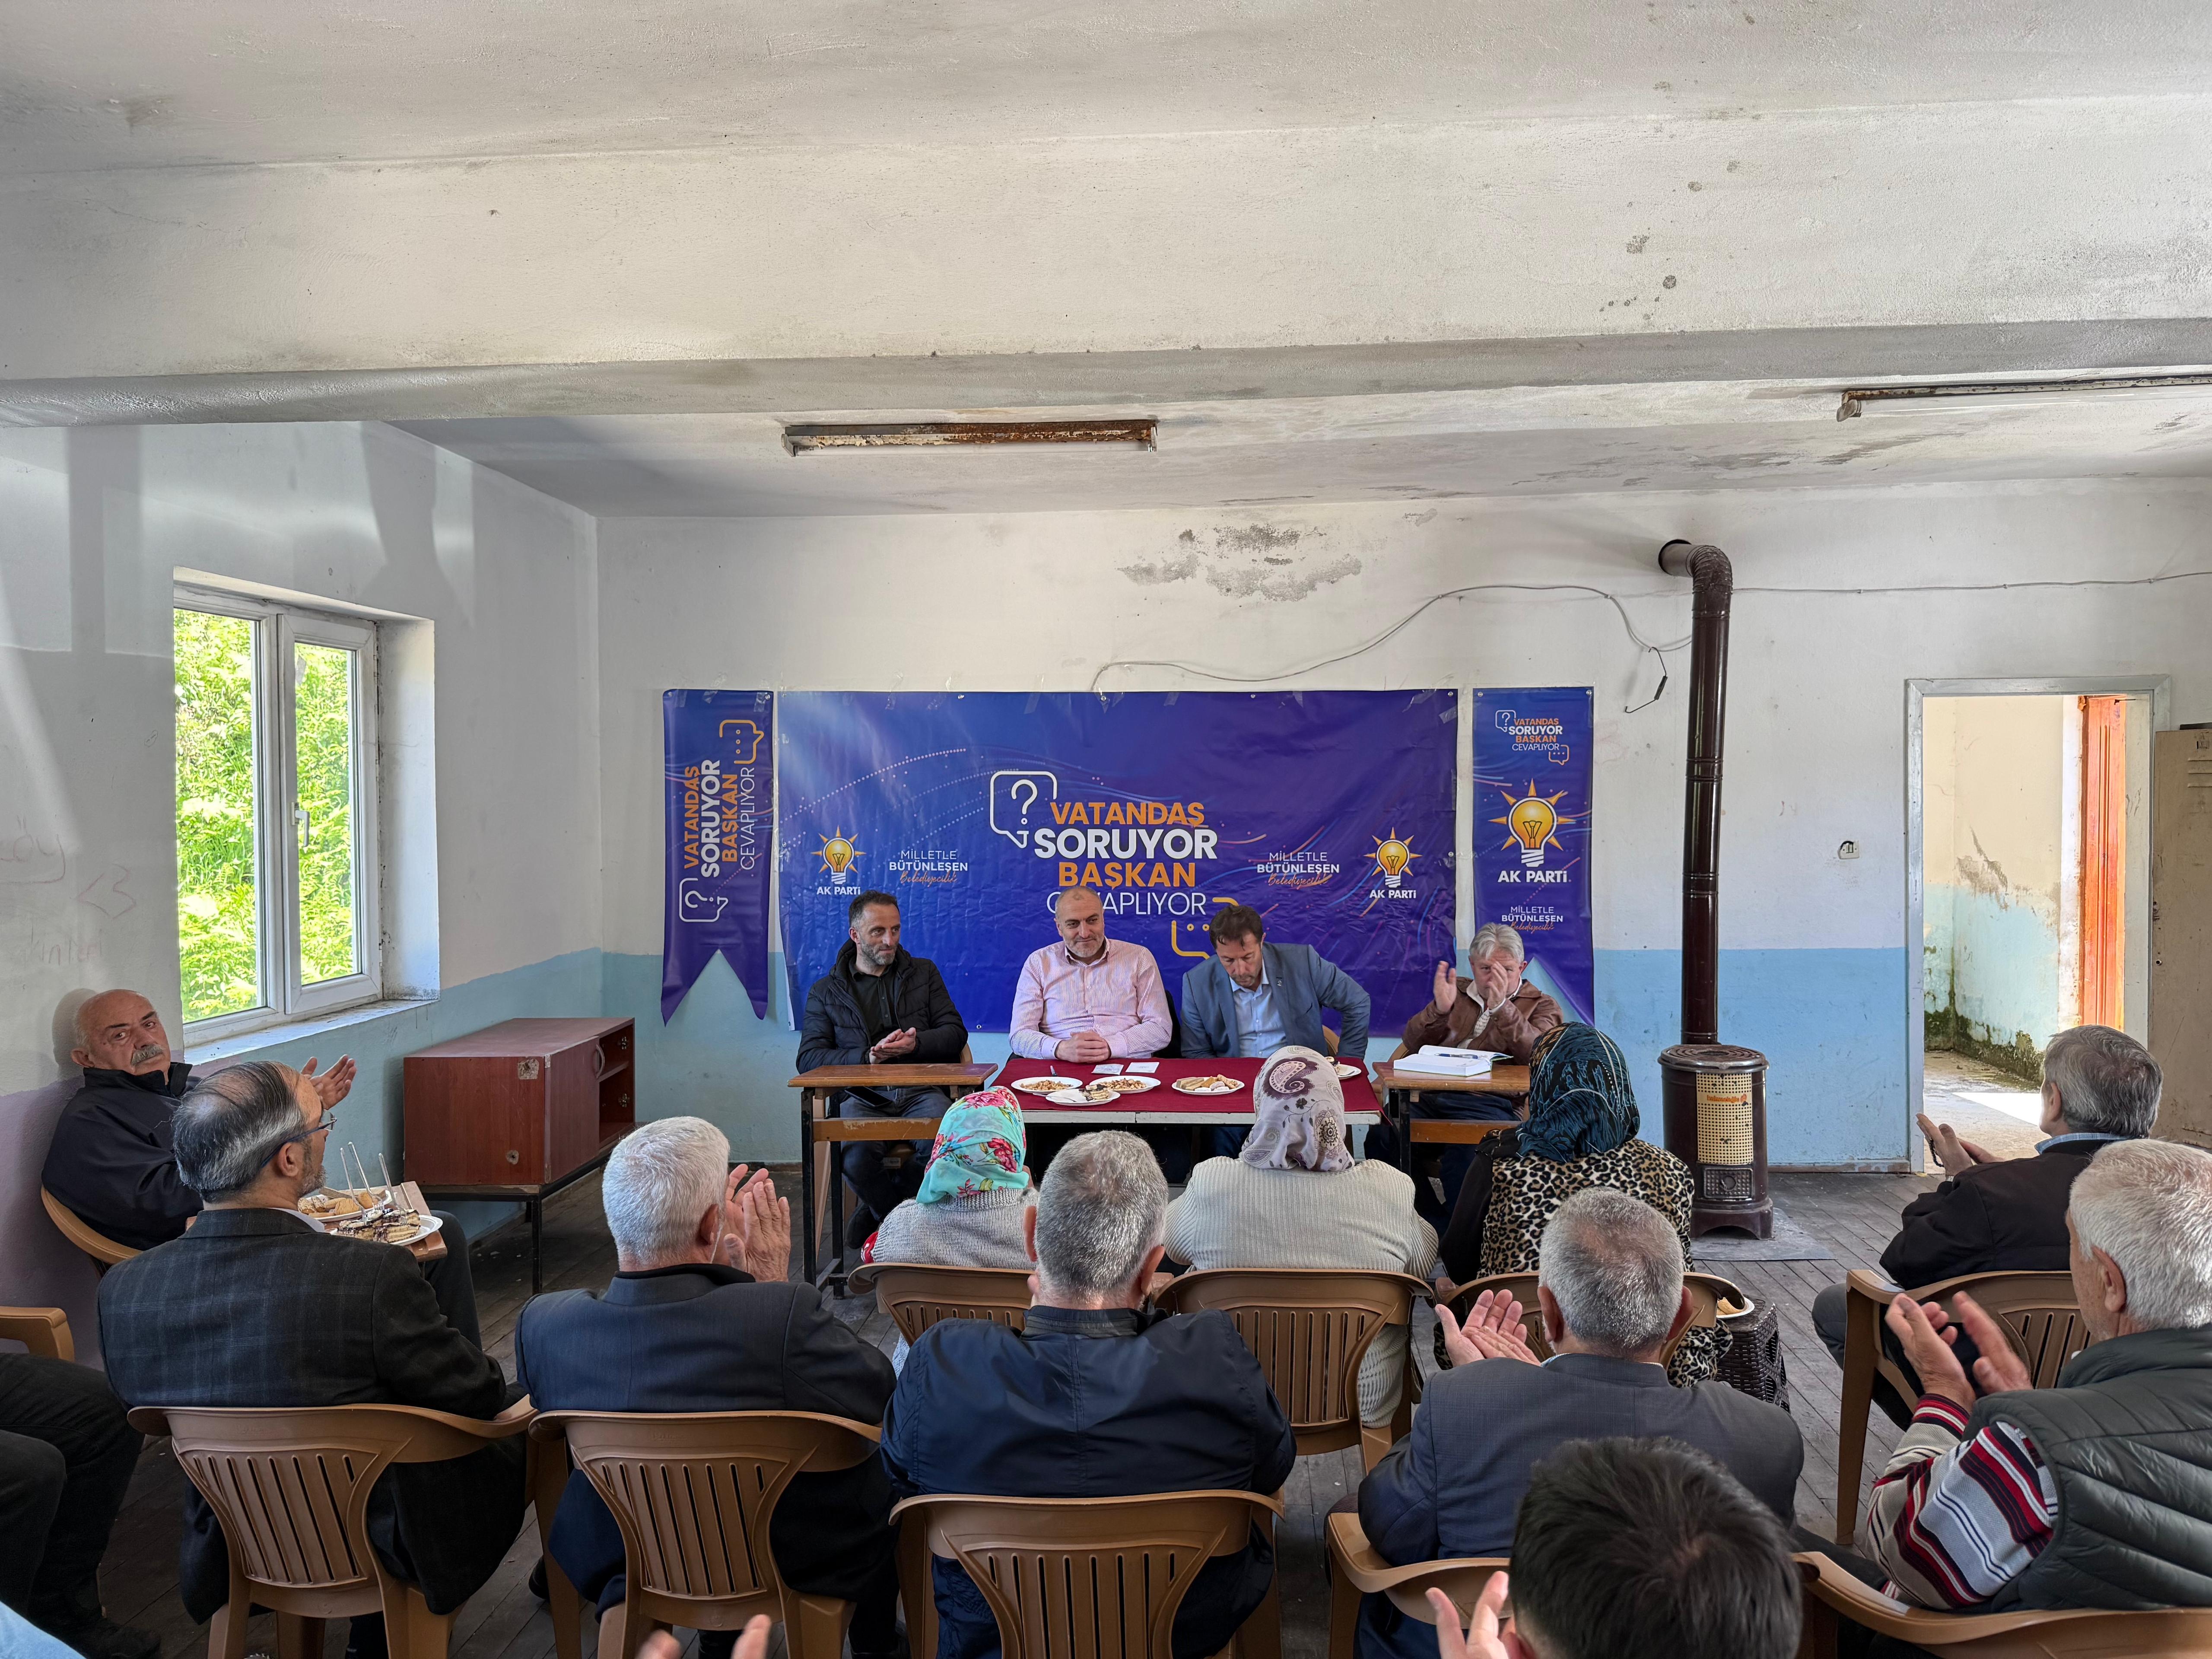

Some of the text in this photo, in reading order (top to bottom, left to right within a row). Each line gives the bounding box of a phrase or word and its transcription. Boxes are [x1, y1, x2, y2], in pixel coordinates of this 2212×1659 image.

[1508, 725, 1563, 735] SORUYOR
[684, 766, 701, 869] VATANDAŞ
[701, 760, 720, 877] SORUYOR
[722, 774, 739, 862] BAŞKAN
[741, 767, 755, 870] CEVAPLIYOR
[1050, 802, 1205, 828] VATANDAŞ
[1034, 828, 1218, 859] SORUYOR
[901, 849, 957, 860] MİLLETLE
[1269, 851, 1328, 861] MİLLETLE
[889, 860, 968, 873] BÜTÜNLEŞEN
[1257, 862, 1340, 874] BÜTÜNLEŞEN
[1058, 862, 1196, 890] BAŞKAN
[1498, 870, 1521, 883] AK
[816, 887, 832, 895] AK
[1369, 890, 1386, 899] AK
[1510, 905, 1554, 913] MİLLETLE
[1501, 913, 1564, 923] BÜTÜNLEŞEN
